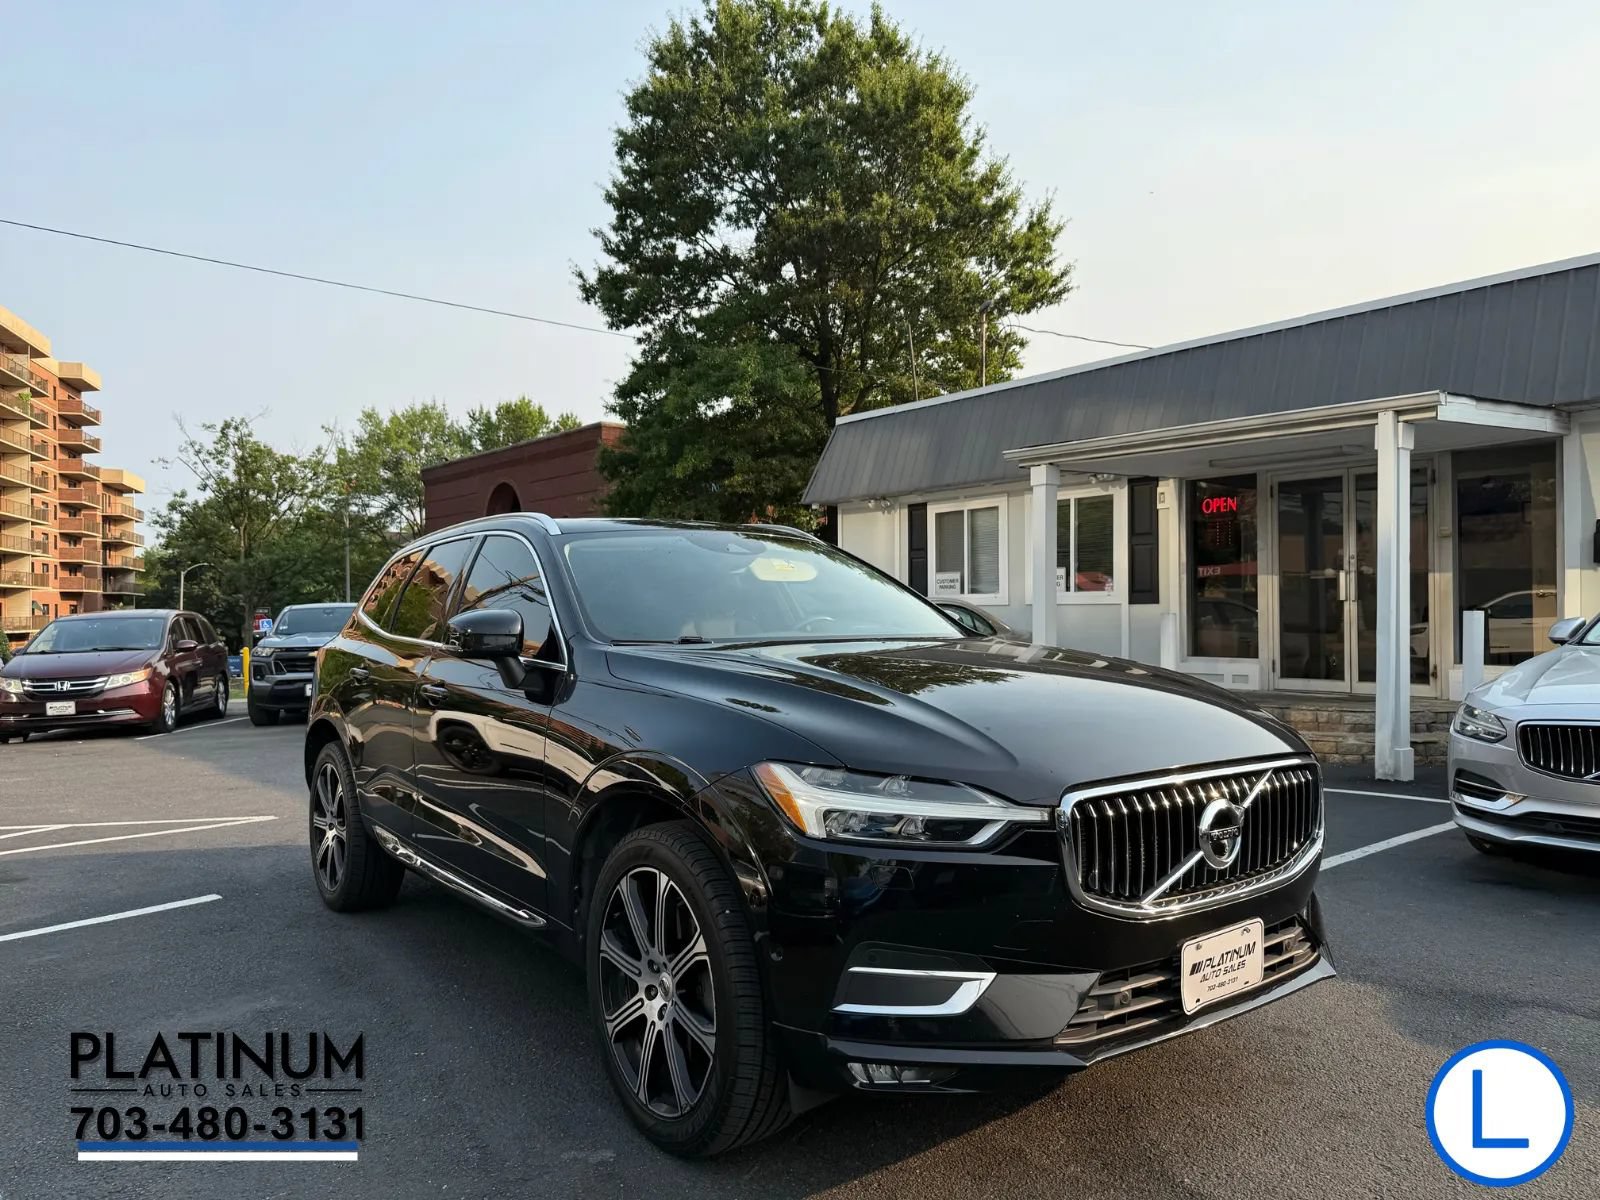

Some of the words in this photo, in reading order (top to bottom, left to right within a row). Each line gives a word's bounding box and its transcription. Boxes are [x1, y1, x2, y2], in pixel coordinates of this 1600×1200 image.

[1202, 496, 1237, 514] OPEN
[1203, 941, 1256, 971] PLATINUM
[1200, 968, 1221, 983] AUTO
[1223, 960, 1246, 975] SALES
